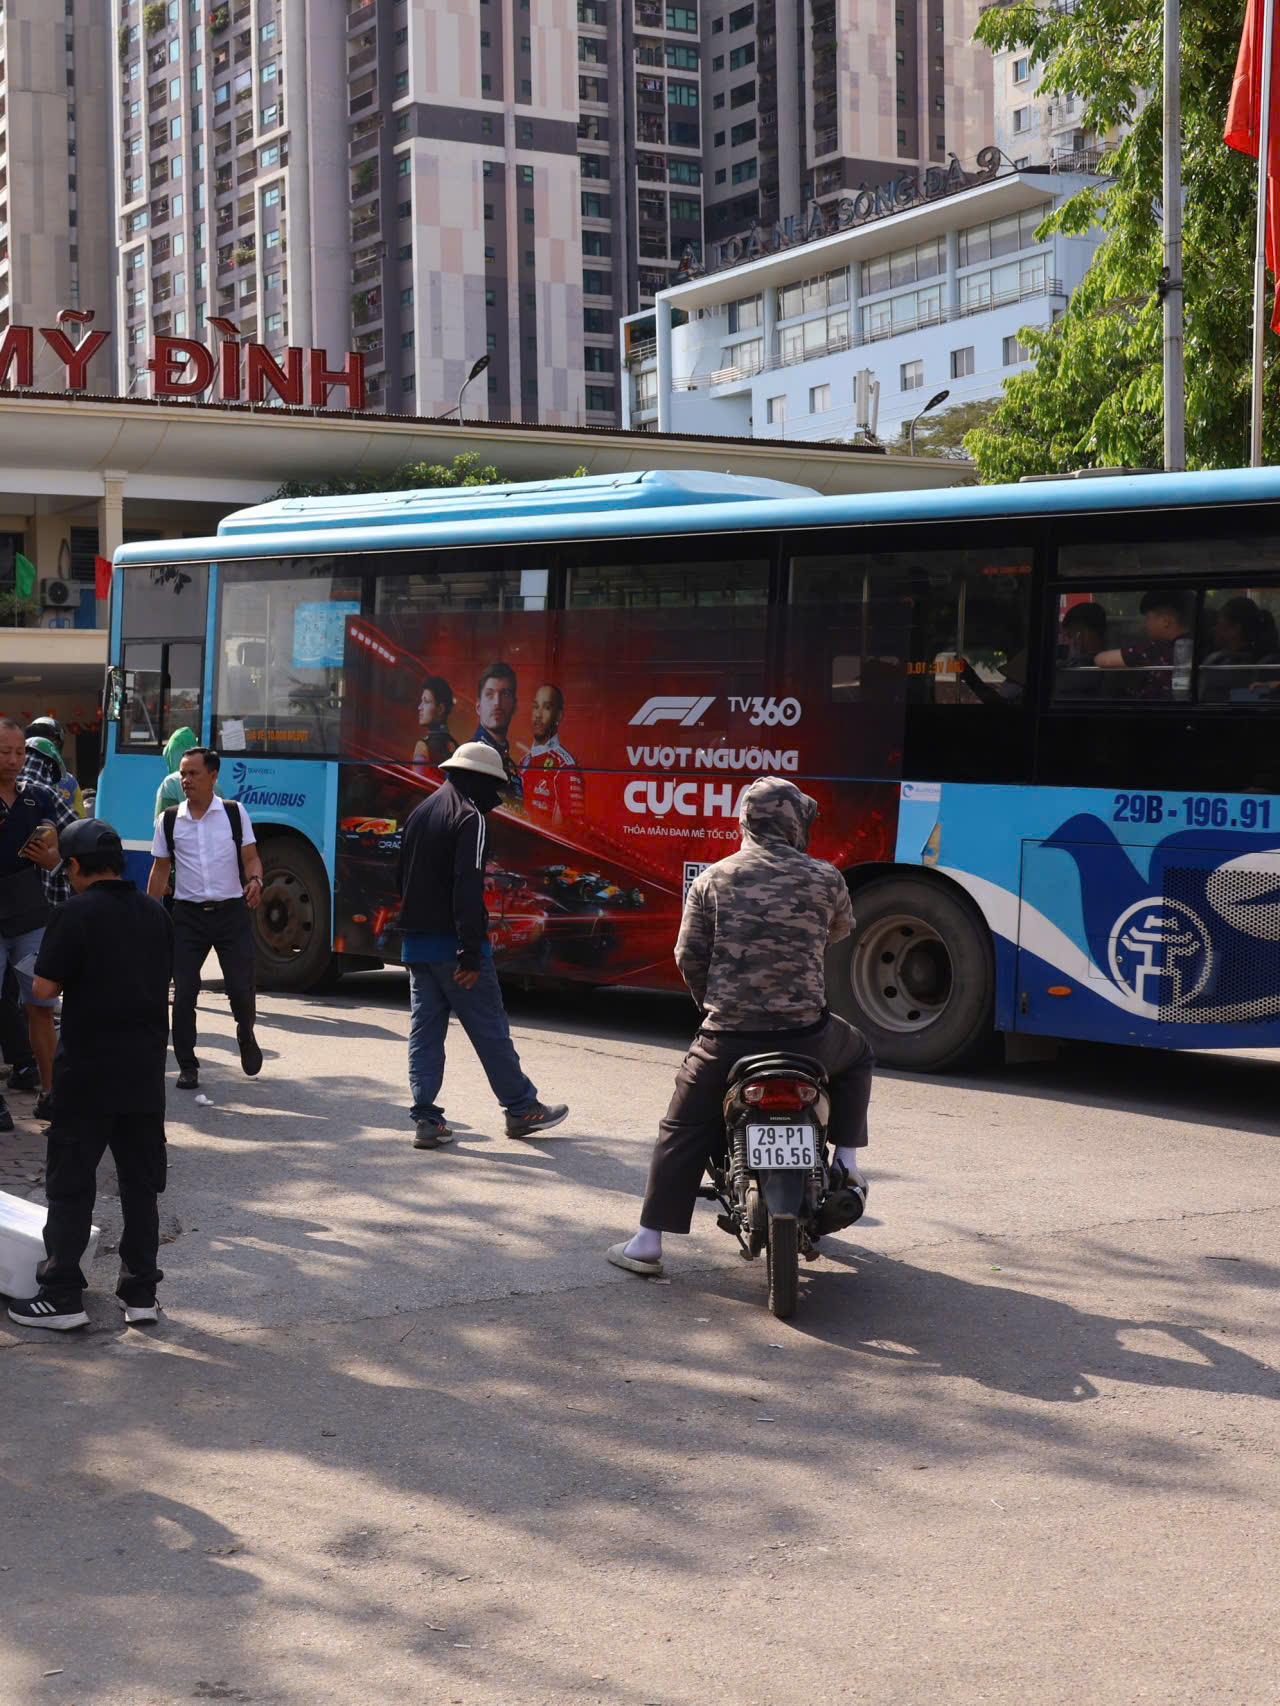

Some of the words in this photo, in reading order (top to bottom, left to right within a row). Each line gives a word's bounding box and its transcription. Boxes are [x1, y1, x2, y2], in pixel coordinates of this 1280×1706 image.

[838, 175, 917, 226] SÔNG
[923, 152, 967, 199] ĐÀ
[977, 146, 1001, 178] 9
[147, 317, 366, 410] ĐÌNH
[728, 696, 802, 727] TV360
[626, 743, 693, 770] VƯỢT
[695, 745, 800, 772] NGƯỠNG
[233, 785, 307, 807] HANOIBUS
[624, 777, 698, 819] CỰC
[647, 825, 669, 836] MÃN
[669, 827, 690, 837] ĐAM
[691, 827, 705, 838] MÊ
[707, 828, 725, 839] TỐC
[757, 1127, 804, 1146] 29-P1
[752, 1147, 812, 1166] 916.56
